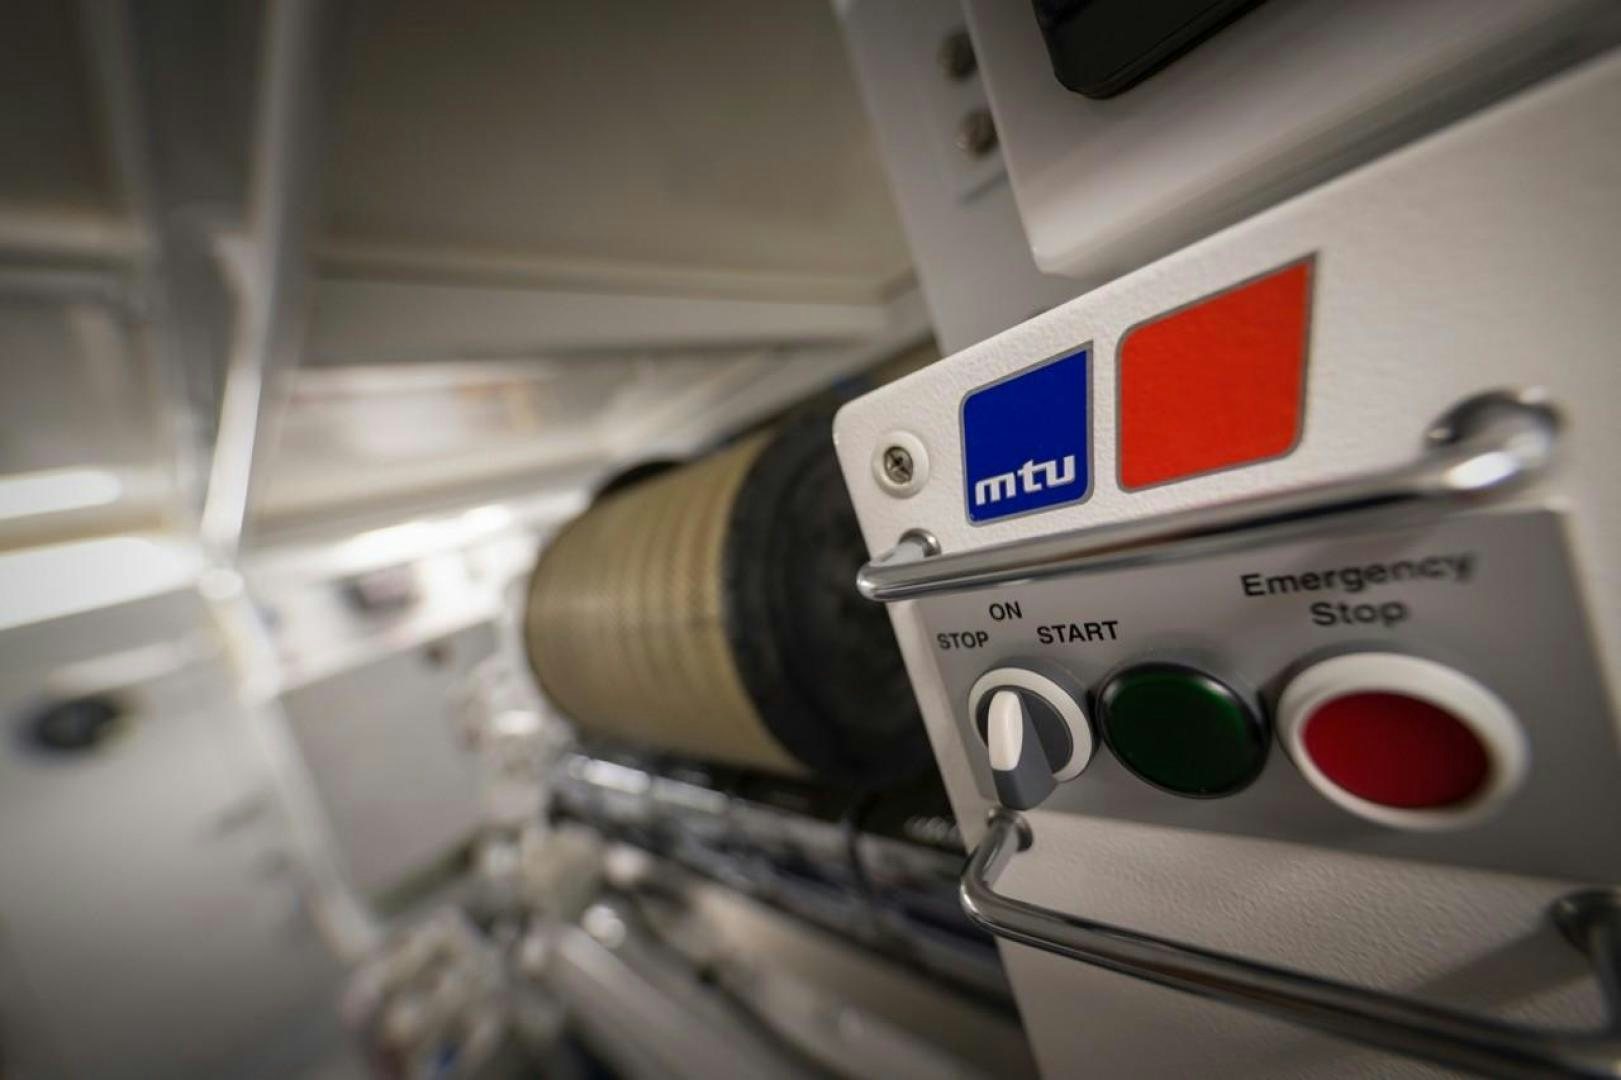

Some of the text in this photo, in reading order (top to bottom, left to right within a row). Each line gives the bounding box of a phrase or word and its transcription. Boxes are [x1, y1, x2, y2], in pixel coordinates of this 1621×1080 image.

[975, 455, 1076, 506] mtu
[1240, 553, 1475, 597] Emergency
[988, 601, 1023, 621] ON
[1310, 602, 1409, 628] Stop
[936, 631, 989, 650] STOP
[1036, 620, 1119, 644] START
